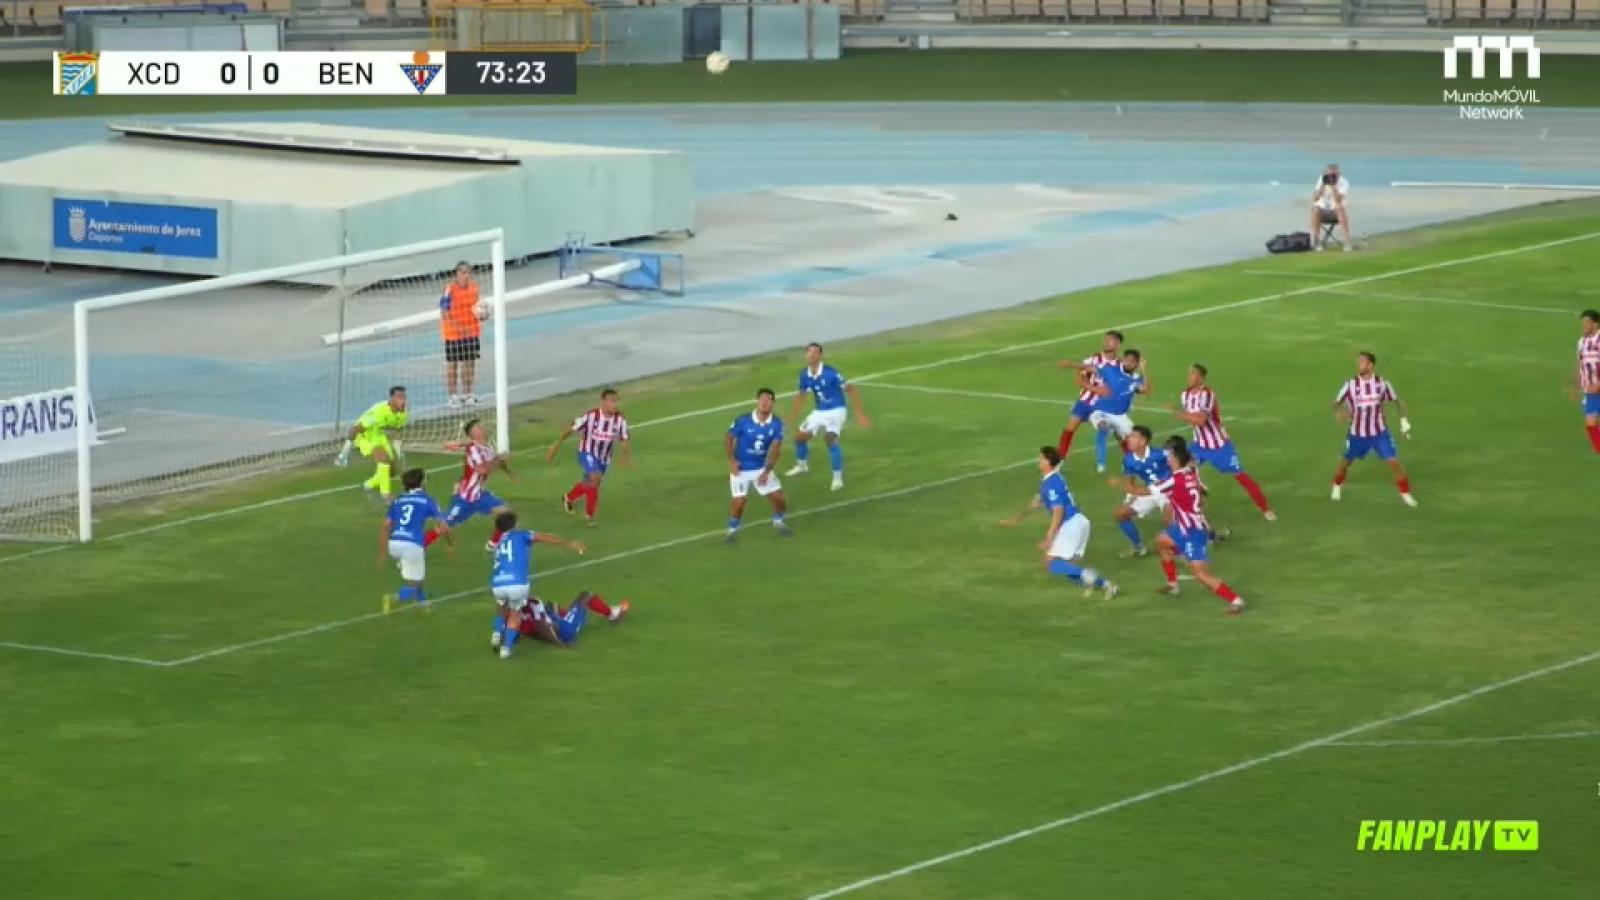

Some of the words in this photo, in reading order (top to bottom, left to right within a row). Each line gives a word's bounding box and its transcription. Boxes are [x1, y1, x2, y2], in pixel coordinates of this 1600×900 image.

[161, 222, 174, 235] de
[175, 225, 201, 238] Jerez
[399, 504, 414, 526] 3
